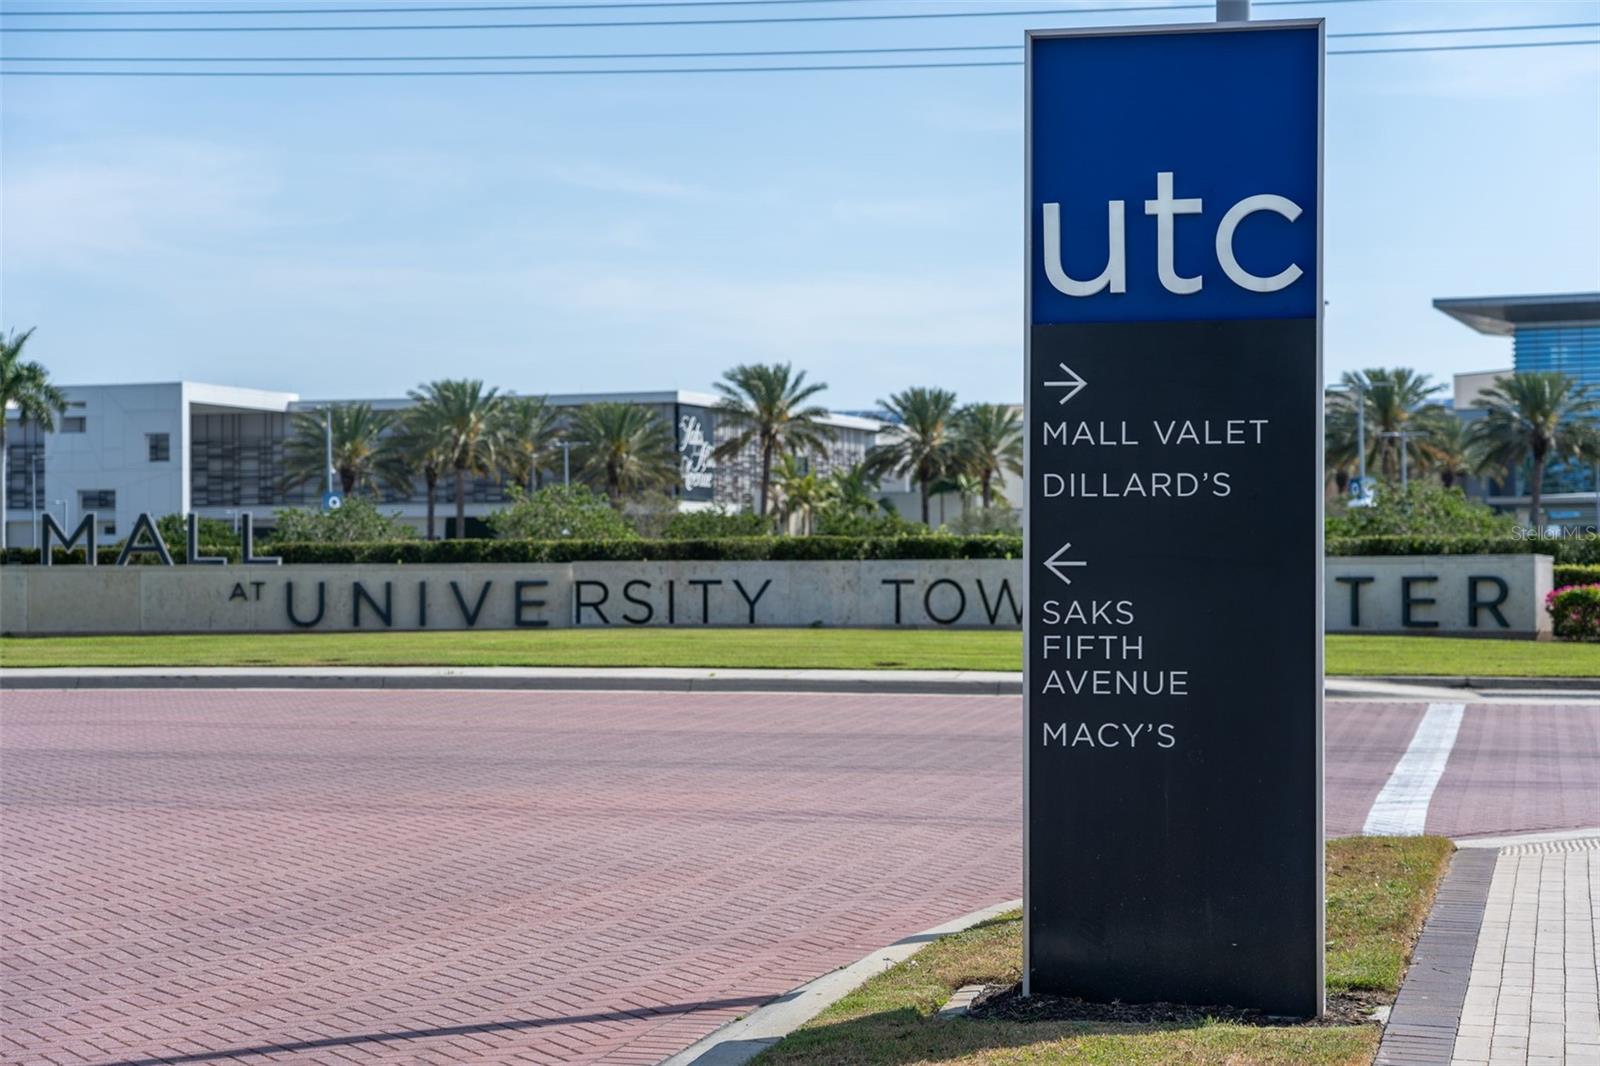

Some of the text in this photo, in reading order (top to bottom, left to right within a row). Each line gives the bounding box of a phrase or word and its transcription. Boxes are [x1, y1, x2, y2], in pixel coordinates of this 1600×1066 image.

[1043, 171, 1304, 297] utc
[1043, 419, 1269, 446] MALL VALET
[1043, 472, 1231, 498] DILLARD'S
[41, 512, 282, 566] MALL
[229, 576, 1510, 628] AT UNIVERSITY TOW TER
[1042, 600, 1134, 625] SAKS
[1043, 635, 1143, 660] FIFTH
[1042, 669, 1188, 696] AVENUE
[1043, 722, 1176, 748] MACY'S
